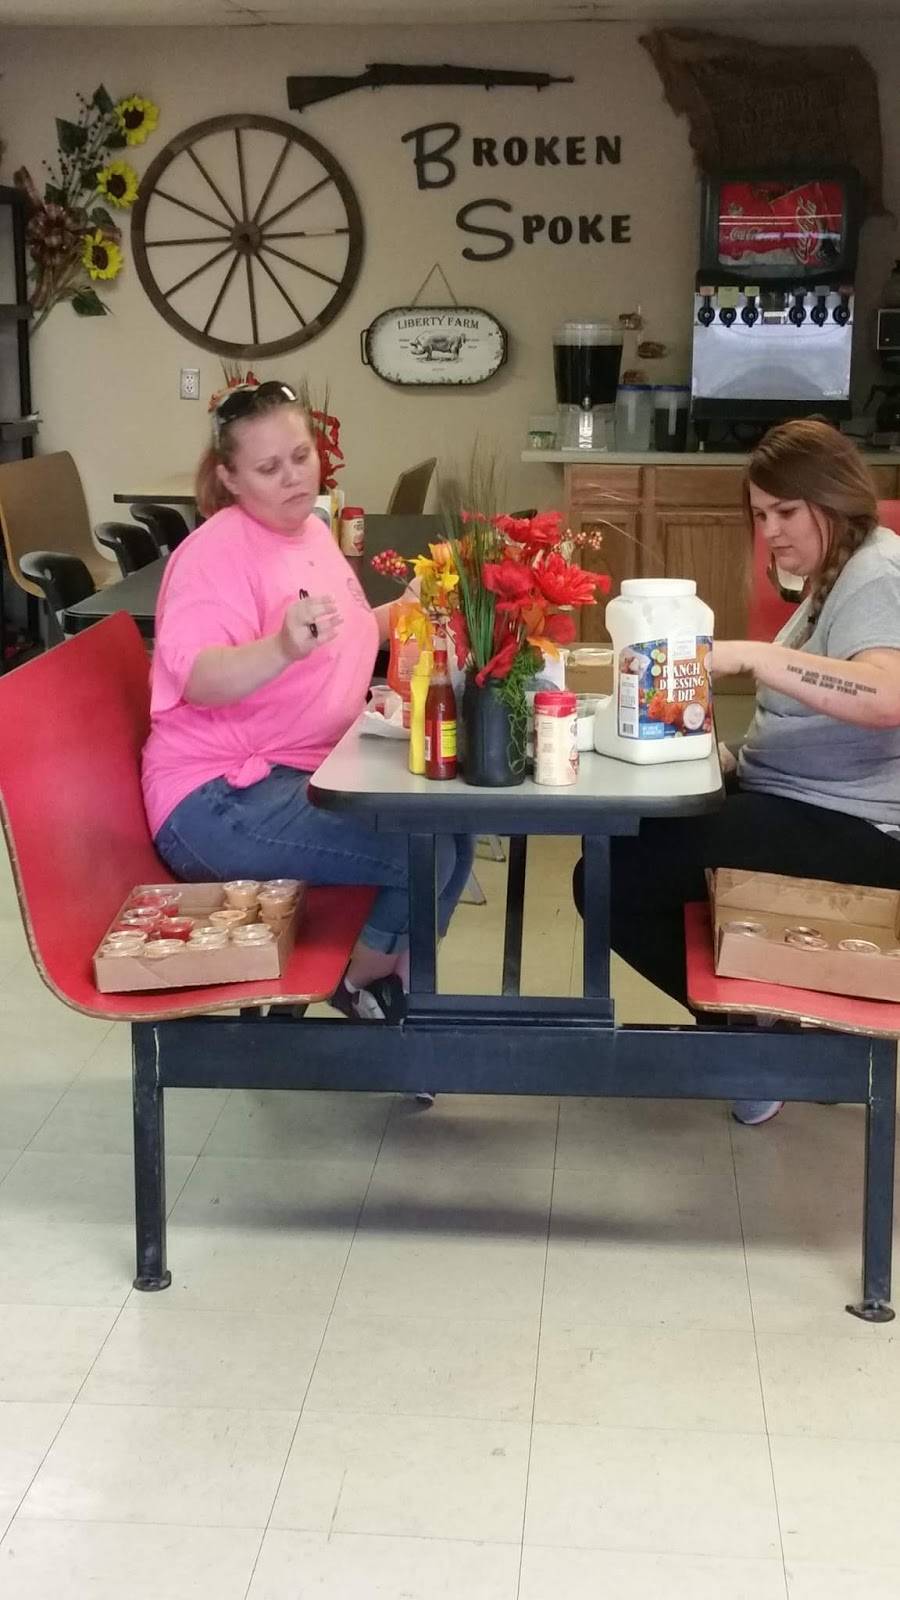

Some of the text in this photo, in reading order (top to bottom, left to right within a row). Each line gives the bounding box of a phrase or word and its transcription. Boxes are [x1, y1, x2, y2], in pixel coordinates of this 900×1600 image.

[401, 122, 622, 190] BROKEN
[456, 198, 631, 262] SPOKE
[397, 315, 480, 330] LIBERTY FARM
[662, 662, 701, 678] RANCH
[678, 688, 696, 702] DIP
